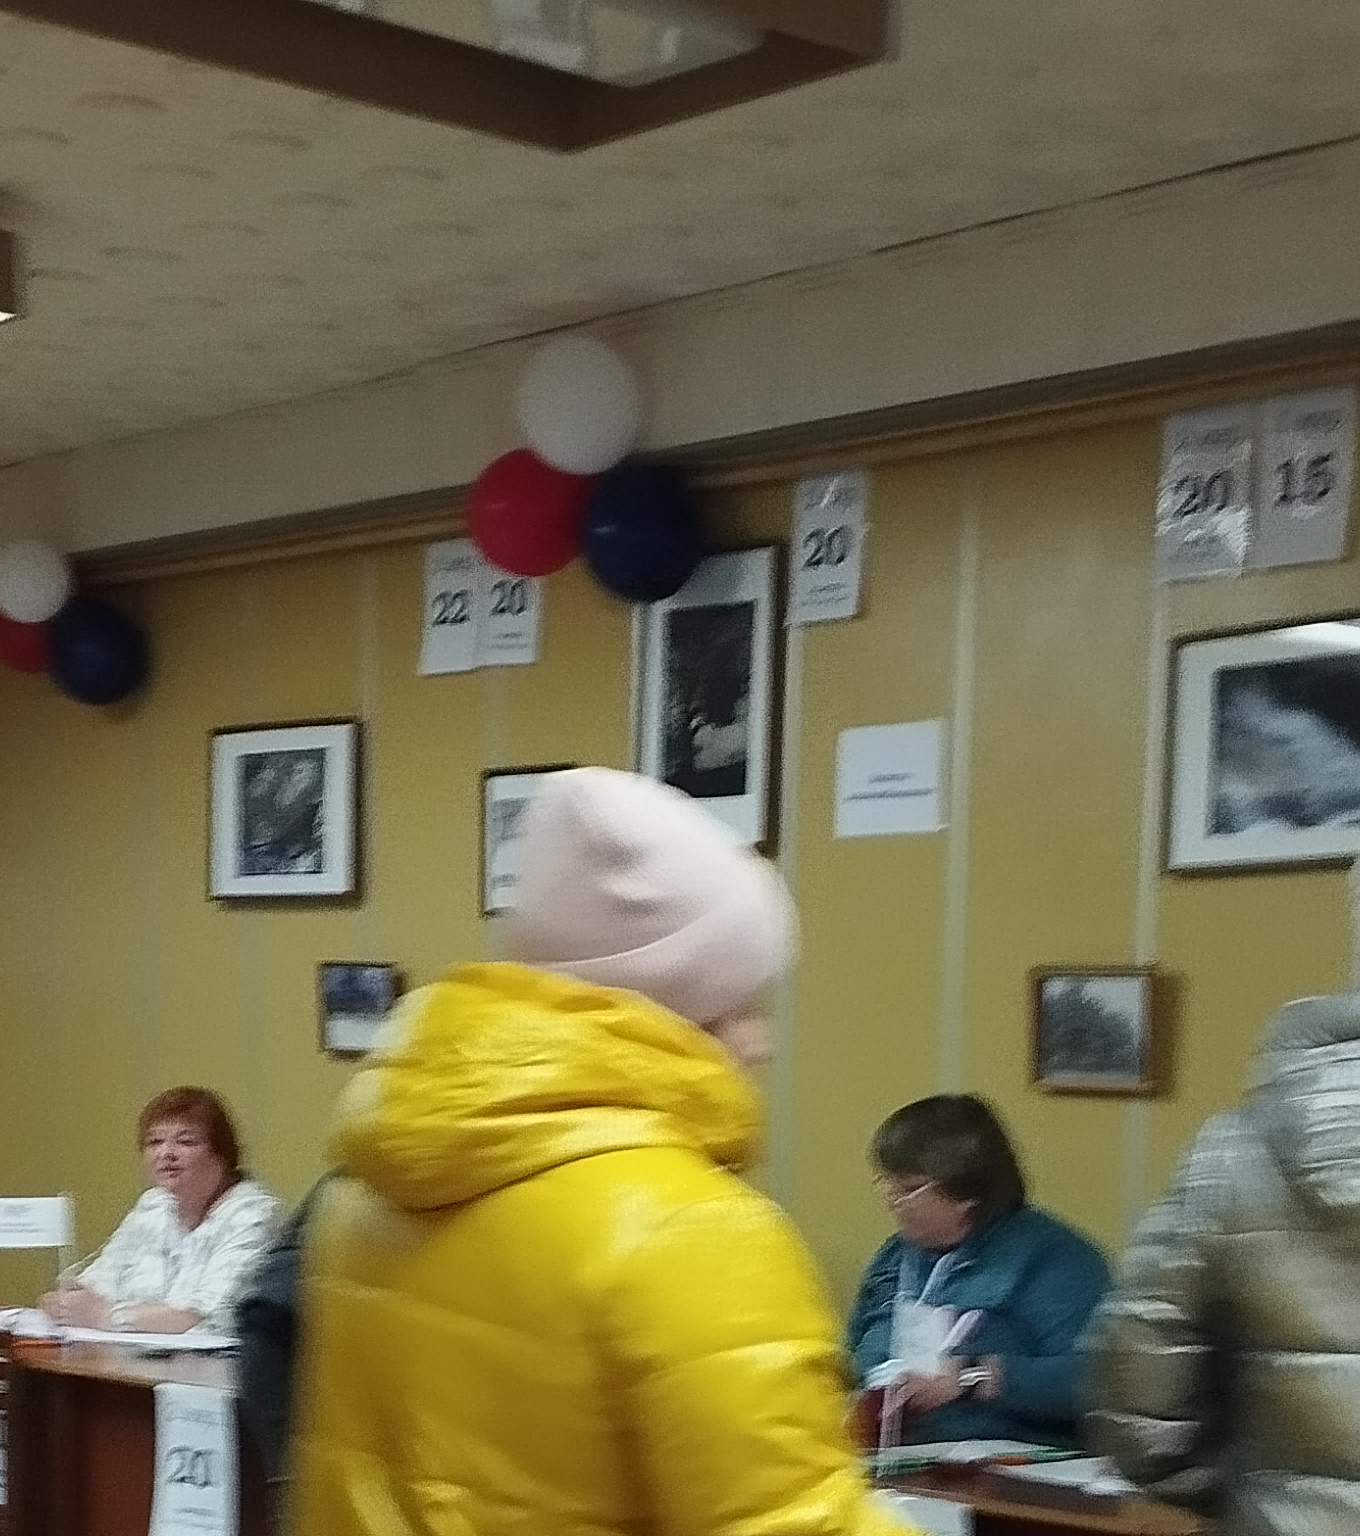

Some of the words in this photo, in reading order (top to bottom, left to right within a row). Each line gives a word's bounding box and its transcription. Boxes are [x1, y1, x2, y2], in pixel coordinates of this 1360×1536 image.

[1172, 467, 1233, 518] 20
[1275, 452, 1336, 507] 15
[804, 525, 849, 568] 20
[432, 589, 471, 626] 22
[489, 579, 528, 616] 20
[165, 1445, 217, 1490] 20
